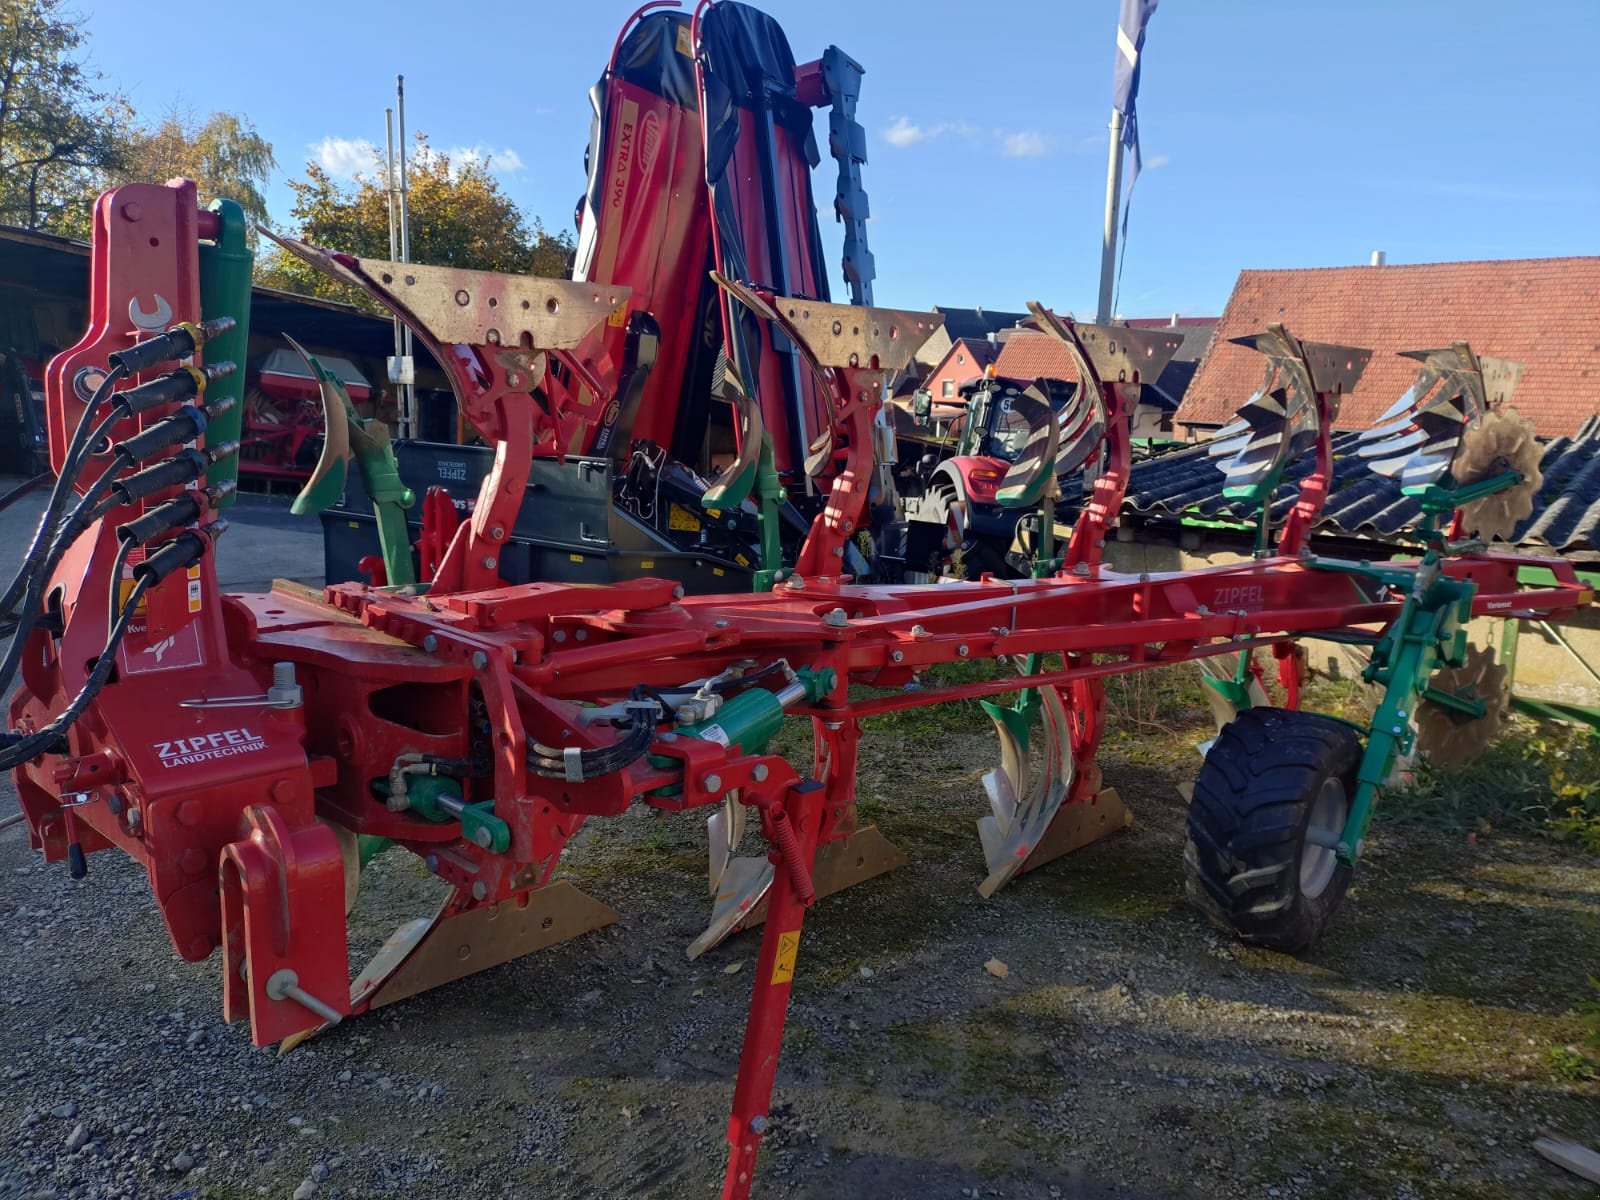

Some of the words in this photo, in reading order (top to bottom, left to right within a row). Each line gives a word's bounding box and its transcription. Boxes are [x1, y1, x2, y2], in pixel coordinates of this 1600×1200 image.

[613, 178, 625, 209] 390
[439, 467, 467, 481] ZIPFEL
[1214, 585, 1265, 605] ZIPFEL
[153, 728, 262, 758] ZIPFEL
[161, 741, 269, 768] LANDTECHNIK
